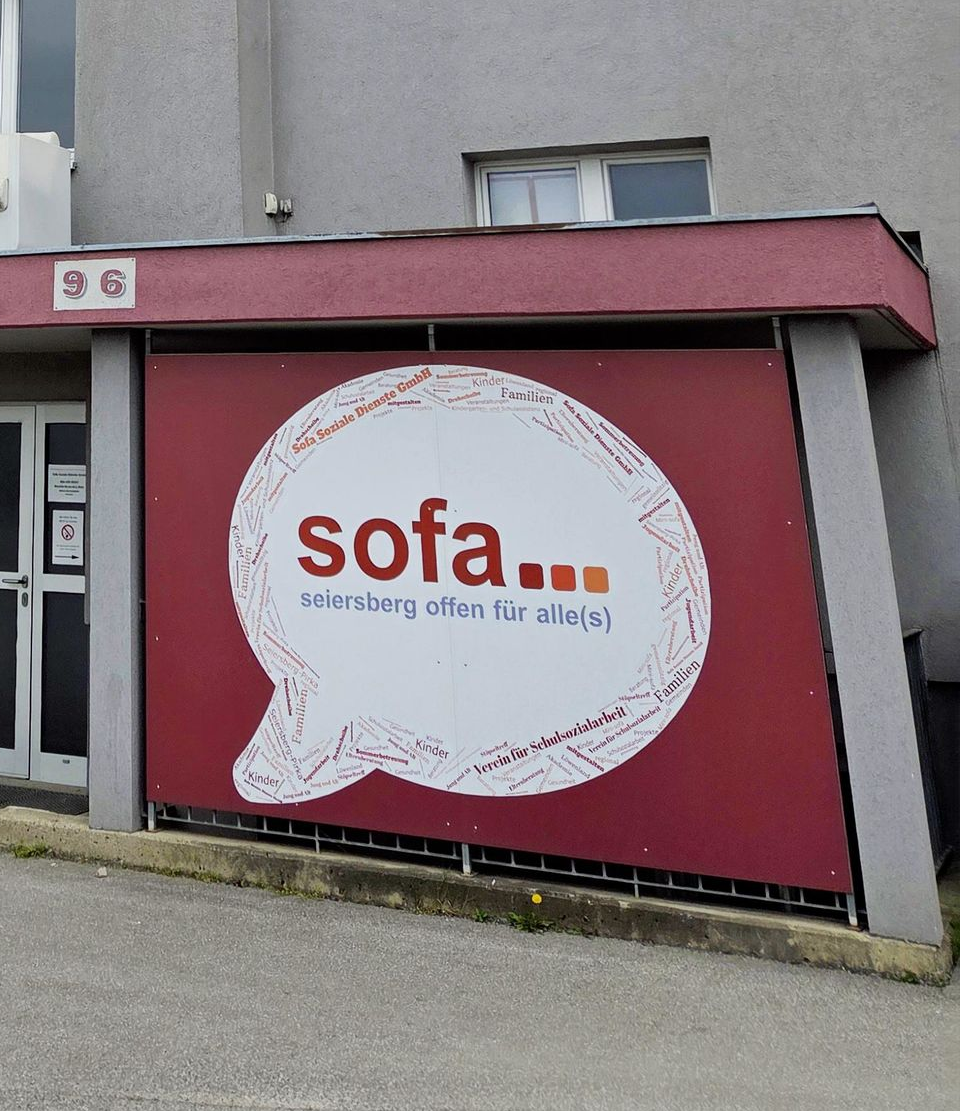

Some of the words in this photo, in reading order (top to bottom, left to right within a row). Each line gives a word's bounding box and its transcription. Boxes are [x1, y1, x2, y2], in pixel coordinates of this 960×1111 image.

[472, 376, 505, 388] Kinder
[500, 387, 554, 405] Familien
[292, 435, 316, 454] Sofa
[316, 413, 355, 440] Soziale
[355, 390, 397, 419] Dienste
[396, 367, 433, 393] GmbH
[232, 524, 244, 558] Kinder
[238, 546, 252, 600] Familien
[662, 562, 683, 598] Kinder
[300, 589, 417, 619] seiersberg
[425, 596, 485, 620] offen
[493, 600, 528, 622] für
[536, 603, 612, 634] alle(s)
[653, 660, 701, 703] Familien
[292, 689, 308, 744] Familien
[416, 738, 450, 760] Kinder
[474, 754, 511, 776] Verein
[510, 746, 530, 762] für
[529, 706, 627, 754] Schulsozialarbeit
[248, 770, 280, 788] Kinder
